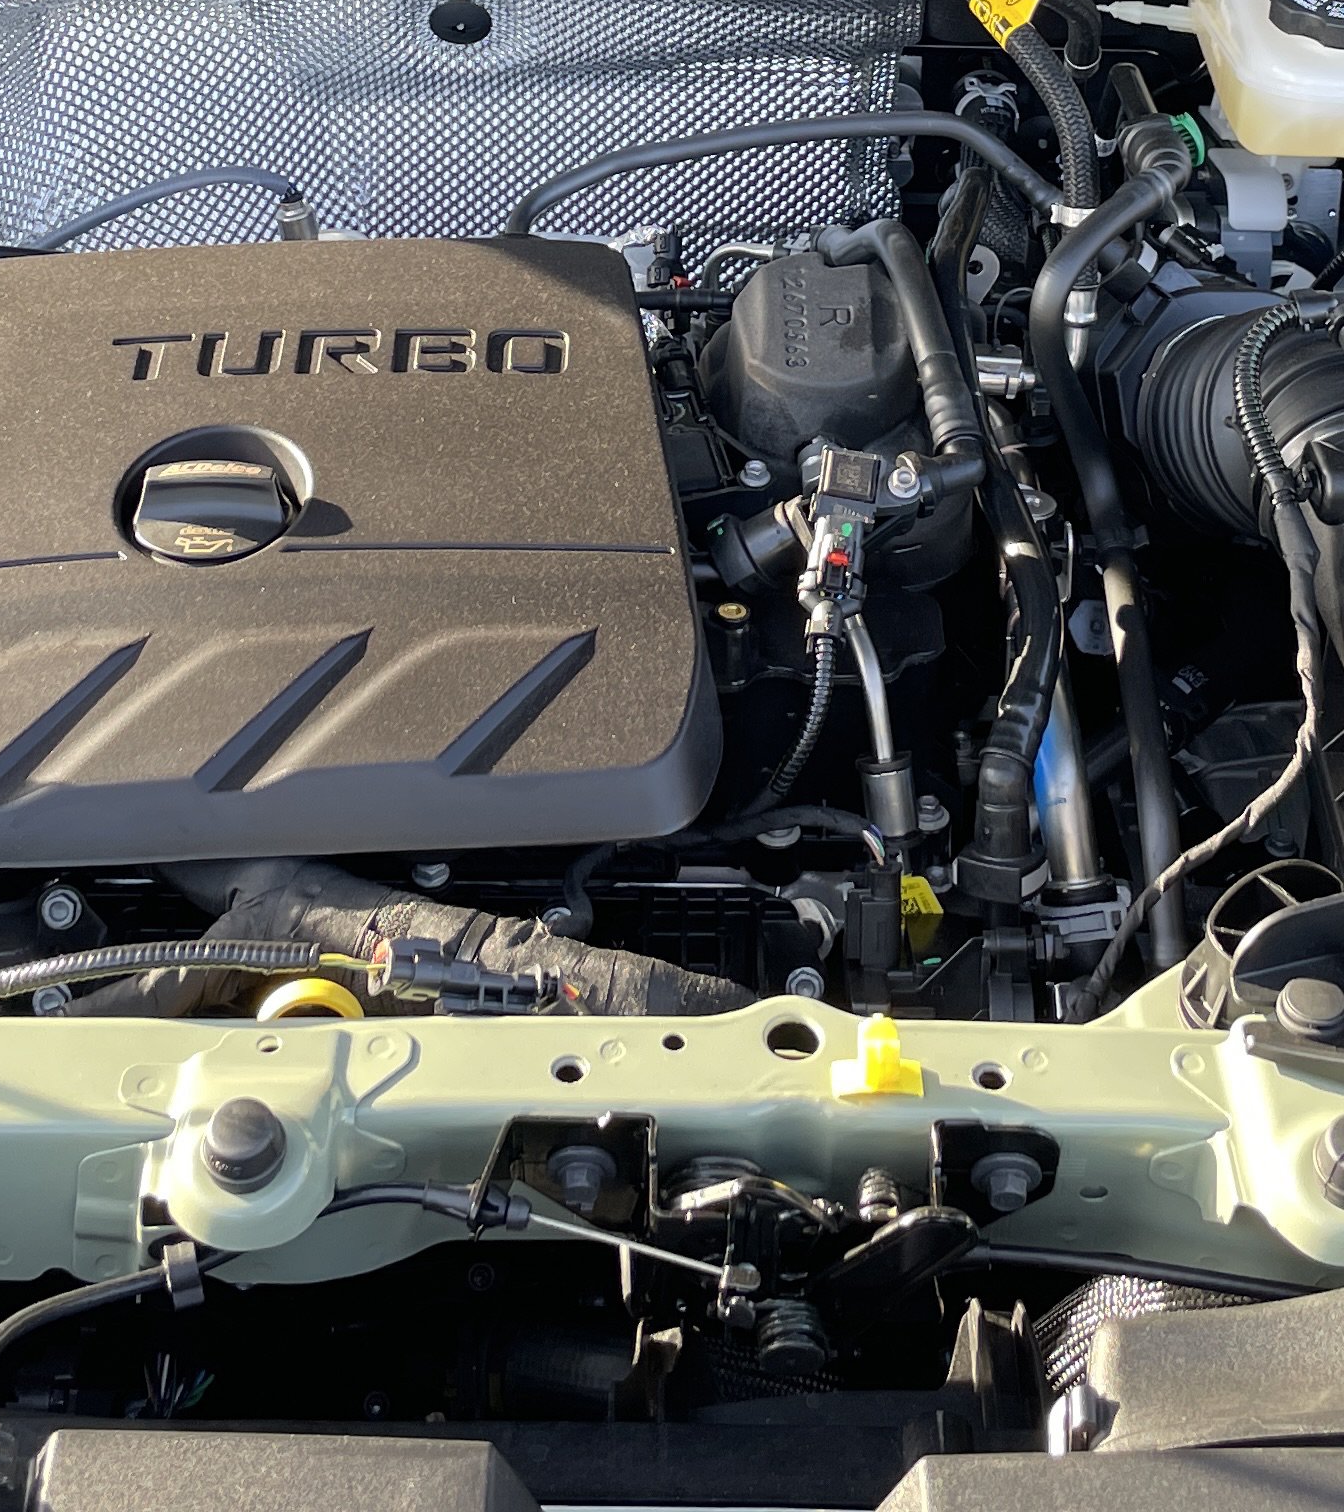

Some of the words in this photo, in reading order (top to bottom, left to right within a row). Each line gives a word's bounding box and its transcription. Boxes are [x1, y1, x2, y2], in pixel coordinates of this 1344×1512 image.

[817, 304, 854, 327] R
[111, 326, 571, 381] TURBO
[158, 462, 262, 478] ACDelco
